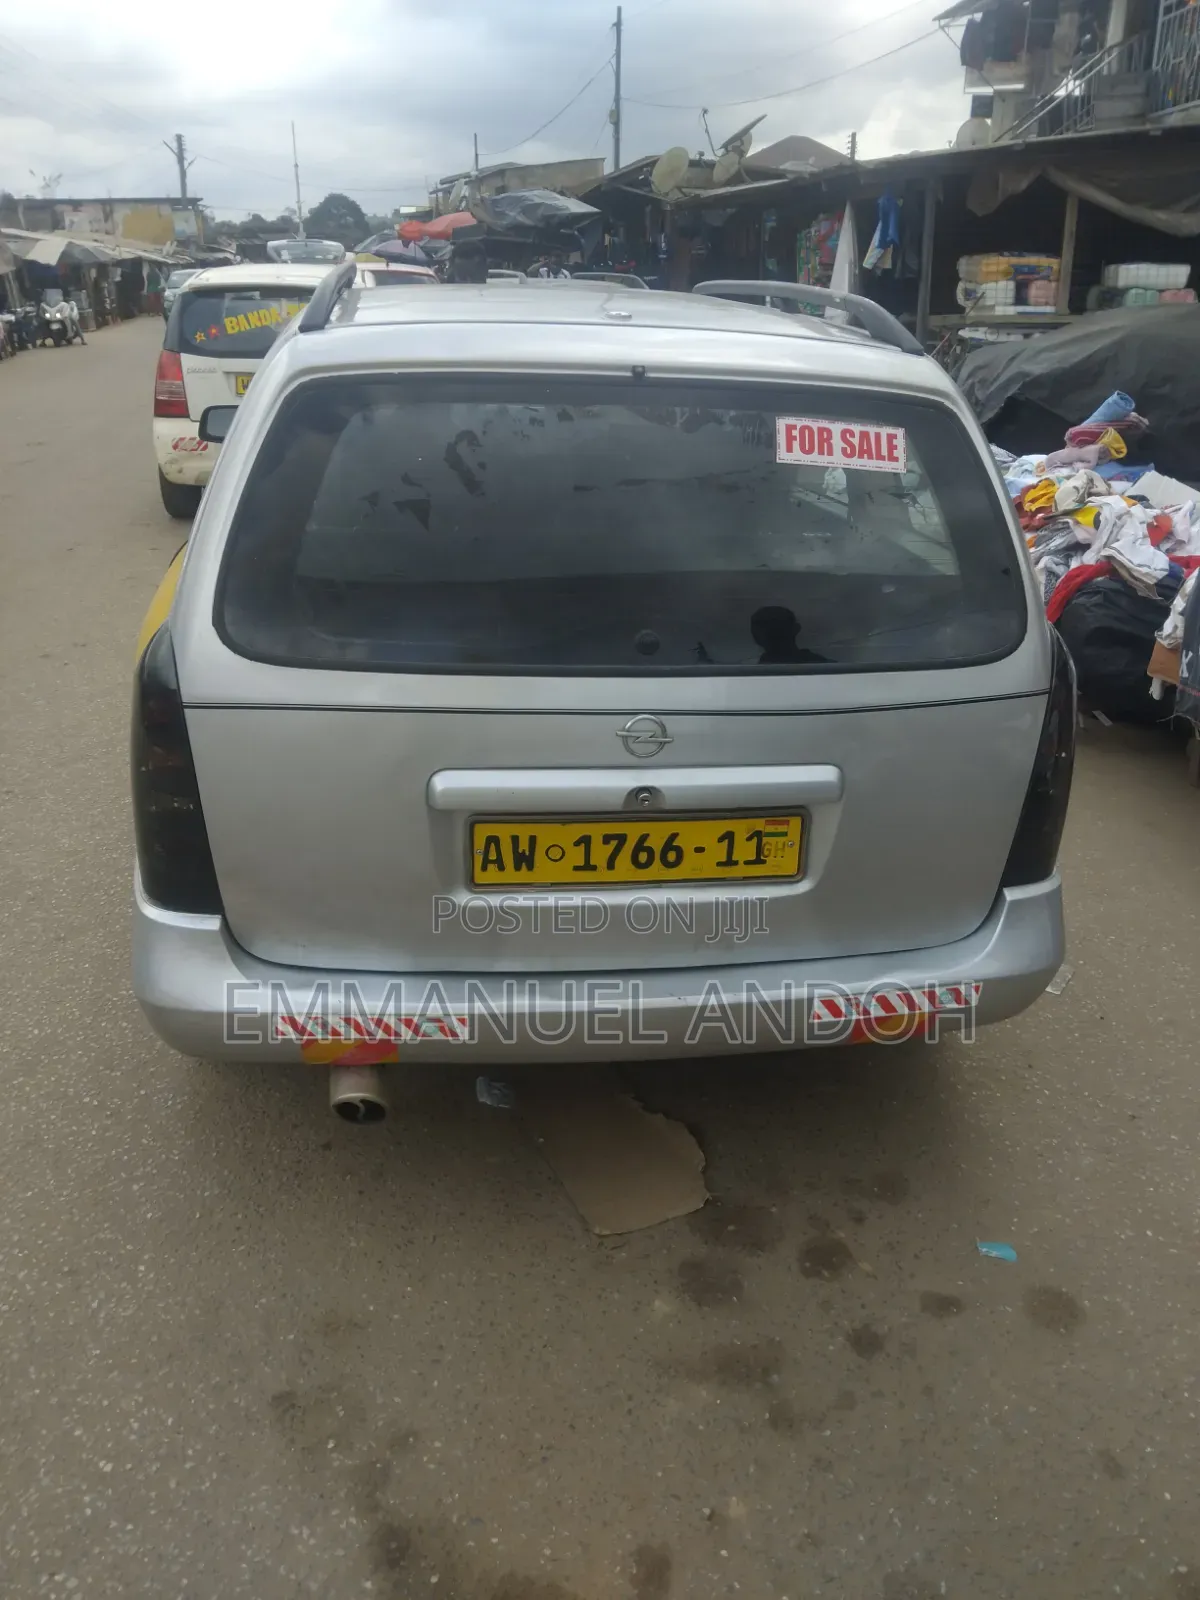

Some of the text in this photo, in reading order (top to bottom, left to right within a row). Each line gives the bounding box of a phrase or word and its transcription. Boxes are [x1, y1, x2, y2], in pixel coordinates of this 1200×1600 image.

[784, 423, 900, 463] FOR SALE
[481, 835, 537, 871] AW
